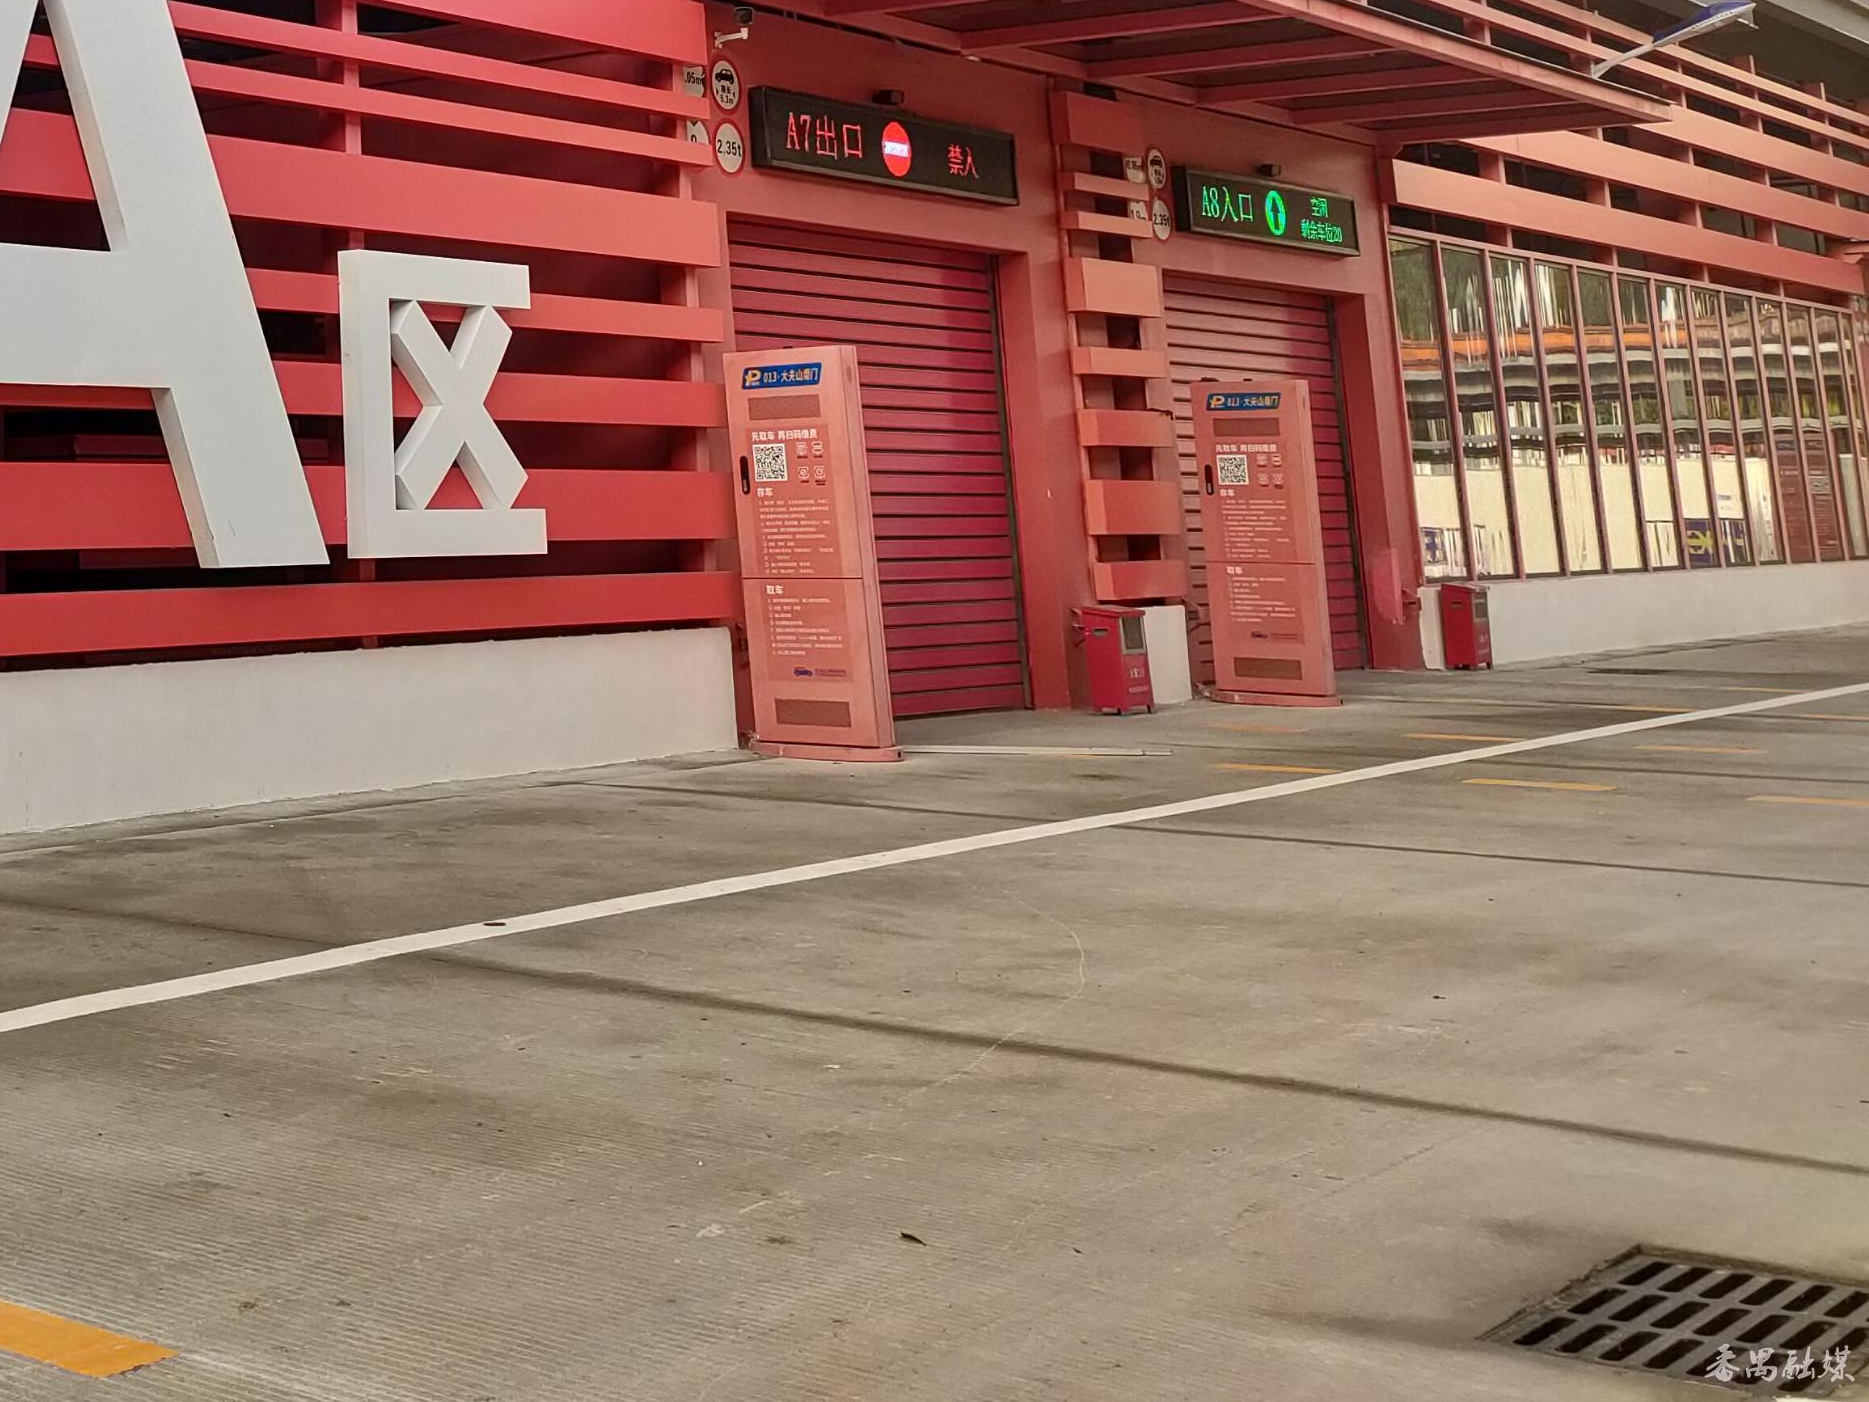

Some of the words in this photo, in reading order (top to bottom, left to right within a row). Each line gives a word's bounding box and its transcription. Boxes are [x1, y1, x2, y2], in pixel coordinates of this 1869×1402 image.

[717, 139, 742, 158] 2.35t
[786, 111, 863, 160] A7出口
[948, 144, 979, 179] 禁入
[1201, 186, 1253, 223] A8入口
